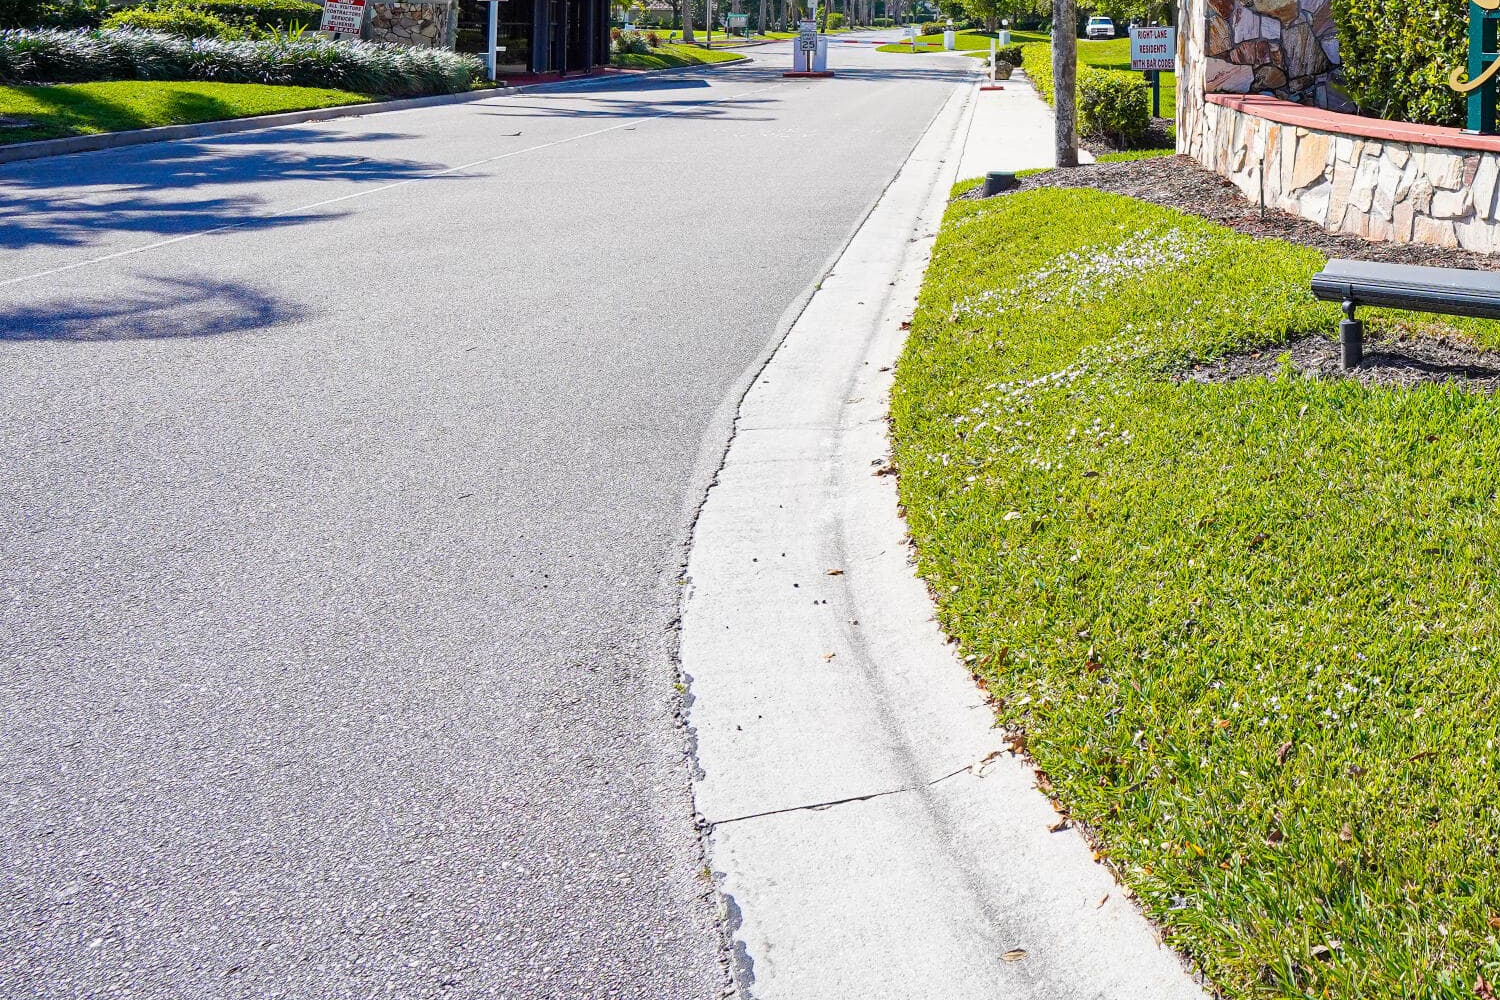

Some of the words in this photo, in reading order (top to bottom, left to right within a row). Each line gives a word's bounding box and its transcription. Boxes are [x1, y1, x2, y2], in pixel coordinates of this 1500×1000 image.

[1137, 30, 1152, 39] RIGHT
[1154, 30, 1167, 38] LANE
[802, 40, 815, 48] 25
[1139, 44, 1167, 54] RESIDENTS
[1132, 60, 1146, 68] WITH
[1146, 59, 1156, 68] BAR
[1158, 58, 1175, 68] CODES
